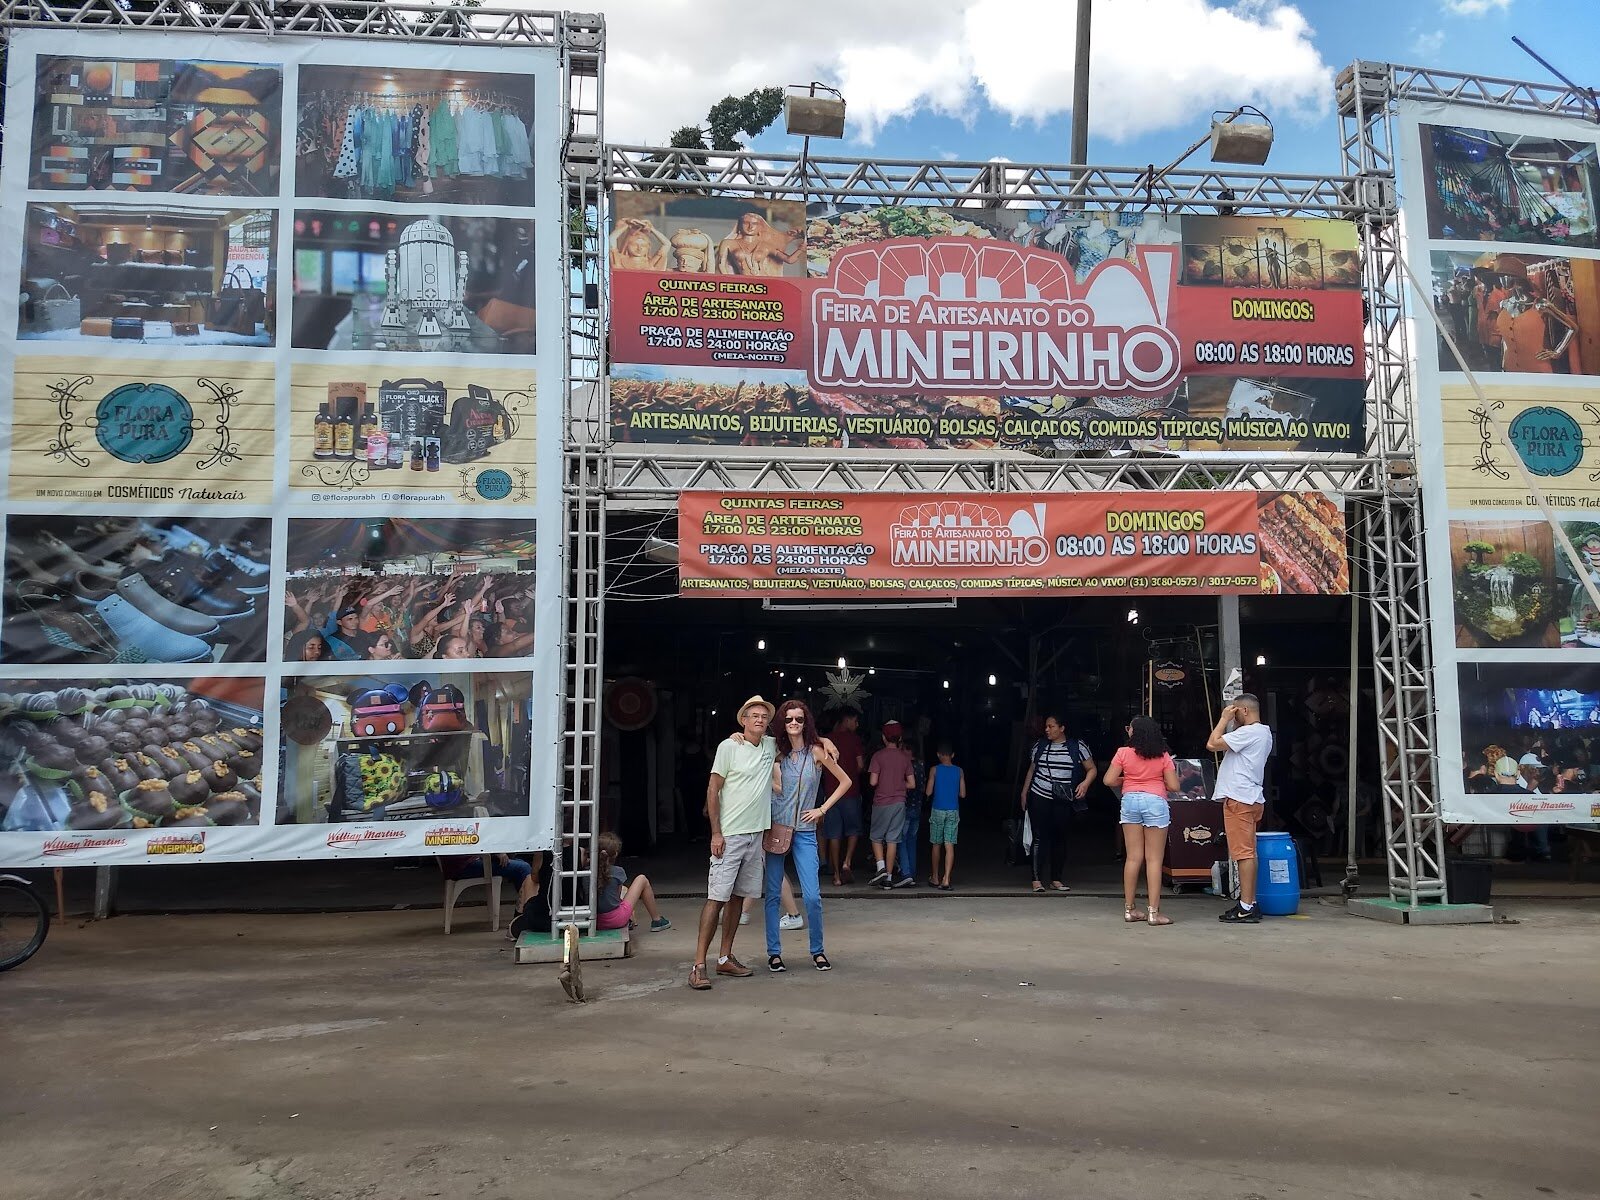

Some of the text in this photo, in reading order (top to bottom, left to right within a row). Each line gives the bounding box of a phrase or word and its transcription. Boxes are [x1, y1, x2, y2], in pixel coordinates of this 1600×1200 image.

[659, 279, 767, 294] QUINTAS FEIRAS:
[644, 292, 782, 311] ÁREA DE ARTESANATO
[643, 305, 784, 321] 17:00 AS 23:00 HORAS
[822, 298, 1089, 327] FEIRA DE ARTESANATO DO
[1232, 300, 1315, 320] DOMINGOS:
[640, 325, 794, 343] PRAÇA DE ALIMENTAÇÃO
[647, 336, 788, 352] 17:00 AS 24:00 HORAS
[712, 352, 785, 363] (MEIA-NOITE)
[822, 328, 1173, 382] MINEIRINHO
[1195, 342, 1354, 365] 08:00 AS 18:00 HORAS
[114, 404, 176, 423] FLORA
[118, 423, 170, 441] PURA
[631, 411, 1350, 440] ARTESANATOS, BIJUTERIAS, VESTUÁRIO, BOLSAS, CALÇADOS, COMIDAS TÍPICAS, MÚSICA AO VIVO!
[1522, 426, 1570, 441] FLORA
[1527, 441, 1567, 457] PURA
[482, 478, 506, 486] FLORA
[107, 483, 174, 499] COSMÉTICOS
[178, 487, 246, 501] Naturais
[322, 493, 376, 502] @florapurabh
[392, 493, 446, 502] @florapurabh
[720, 498, 843, 510] QUINTAS FEIRAS:
[703, 512, 861, 526] ÁREA DE ARTESANATO
[1107, 511, 1205, 531] DOMINGOS
[703, 525, 862, 536] 17:00 AS 23:00 HORAS
[894, 528, 1010, 538] FEIRA DE ARTESANATO DO
[700, 543, 875, 557] PRAÇA DE ALIMENTAÇÃO
[894, 539, 1046, 563] MINEIRINHO
[1056, 534, 1256, 555] 08:00 AS 18:00 HORAS
[708, 555, 867, 566] 17:00 AS 24:00 HORAS
[776, 567, 845, 576] (MEIA-NOITE)
[681, 579, 750, 590] ARTESANATOS,
[753, 579, 809, 590] BIJUTERIAS,
[812, 577, 867, 590] VESTUÁRIO,
[870, 579, 906, 590] BOLSAS,
[909, 579, 958, 591] CALÇADOS,
[961, 579, 1003, 588] COMIDAS
[1005, 577, 1045, 589] TÍPICAS,
[1048, 577, 1082, 587] MÚSICA
[1085, 578, 1098, 587] AO
[1101, 578, 1127, 587] VIVO!
[1129, 577, 1148, 588] (31)
[1200, 577, 1205, 587] /
[1208, 576, 1258, 586] 3017-0573
[1541, 801, 1575, 809] Martins
[364, 830, 406, 838] Martins
[426, 834, 478, 845] MINEIRINHO
[83, 838, 127, 847] Martins
[148, 844, 204, 854] MINEIRINHO
